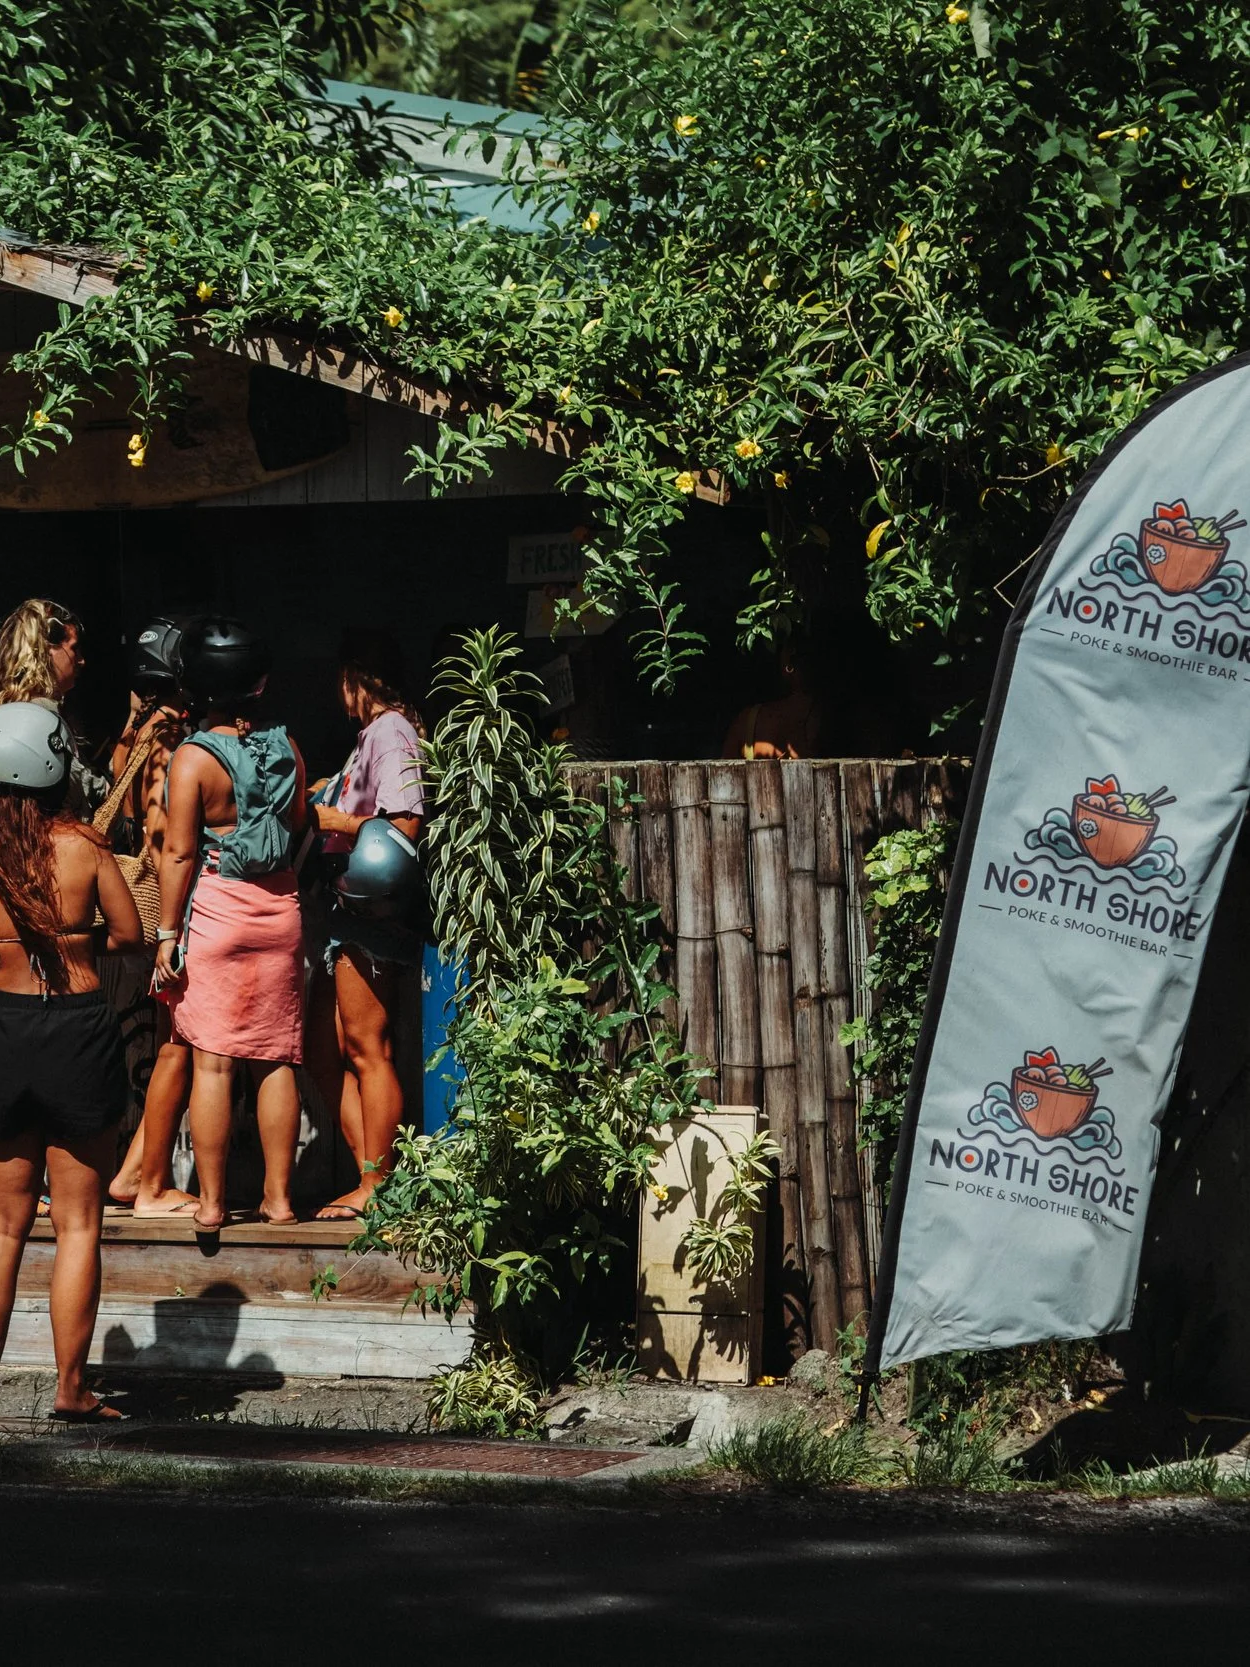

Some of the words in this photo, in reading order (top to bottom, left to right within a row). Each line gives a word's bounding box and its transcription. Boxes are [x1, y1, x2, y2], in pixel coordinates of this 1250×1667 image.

[520, 541, 582, 575] FRESH
[1045, 587, 1163, 641] NORTH
[1171, 620, 1250, 664] SHOR
[1070, 631, 1110, 651] POKE
[1112, 642, 1123, 654] &
[1126, 645, 1205, 674] SMOOTHIE
[1208, 665, 1238, 682] BAR
[983, 862, 1097, 914] NORTH
[1106, 893, 1201, 941] SHORE
[1007, 905, 1047, 924] POKE
[1049, 914, 1060, 926] &
[1063, 917, 1137, 947] SMOOTHIE
[1139, 939, 1168, 957] BAR
[928, 1138, 1039, 1187] NORTH
[1047, 1164, 1139, 1217] SHORE
[955, 1180, 993, 1199] POKE
[996, 1189, 1006, 1201] &
[1010, 1191, 1078, 1218] SMOOTHIE
[1081, 1208, 1109, 1226] BAR
